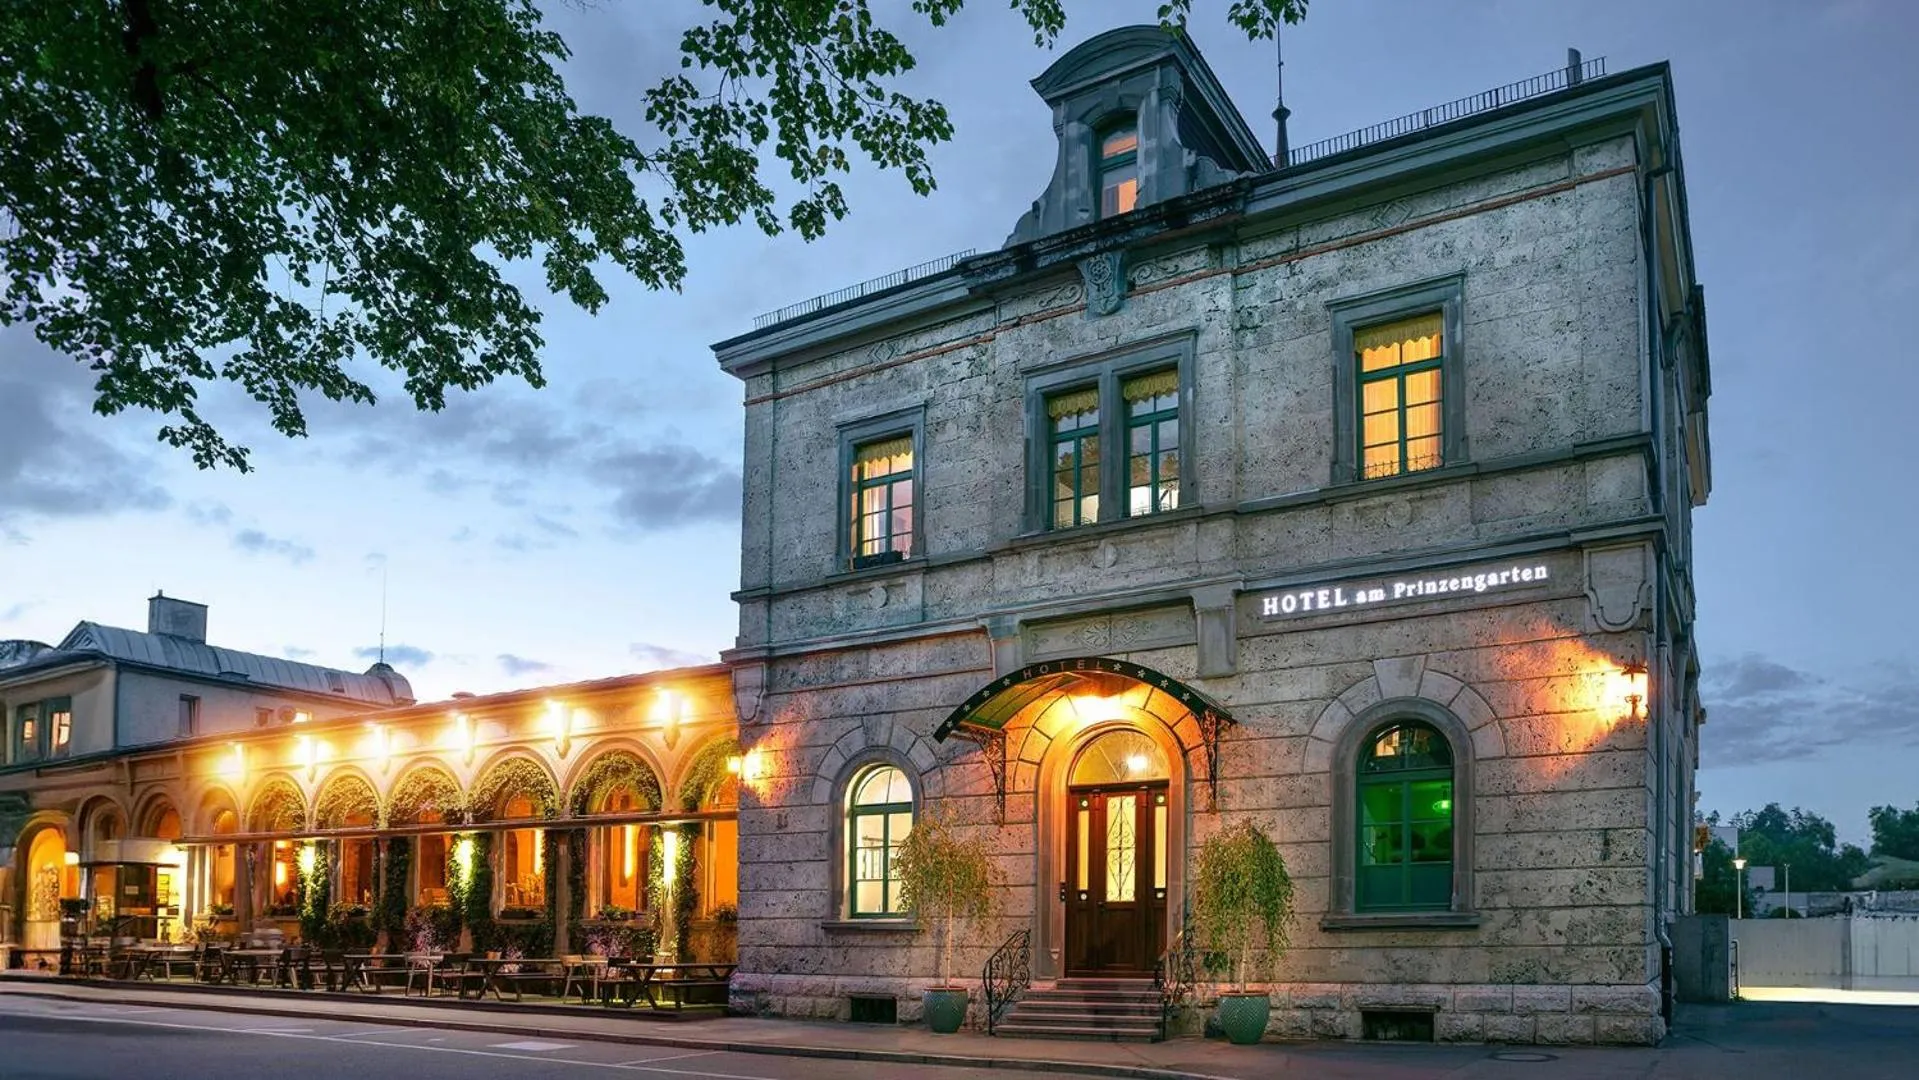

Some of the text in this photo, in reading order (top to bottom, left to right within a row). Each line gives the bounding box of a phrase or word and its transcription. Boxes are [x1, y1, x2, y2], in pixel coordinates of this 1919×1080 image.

[1263, 564, 1548, 616] HOTEL am Prinzengarten
[1022, 659, 1103, 679] HOTEL
